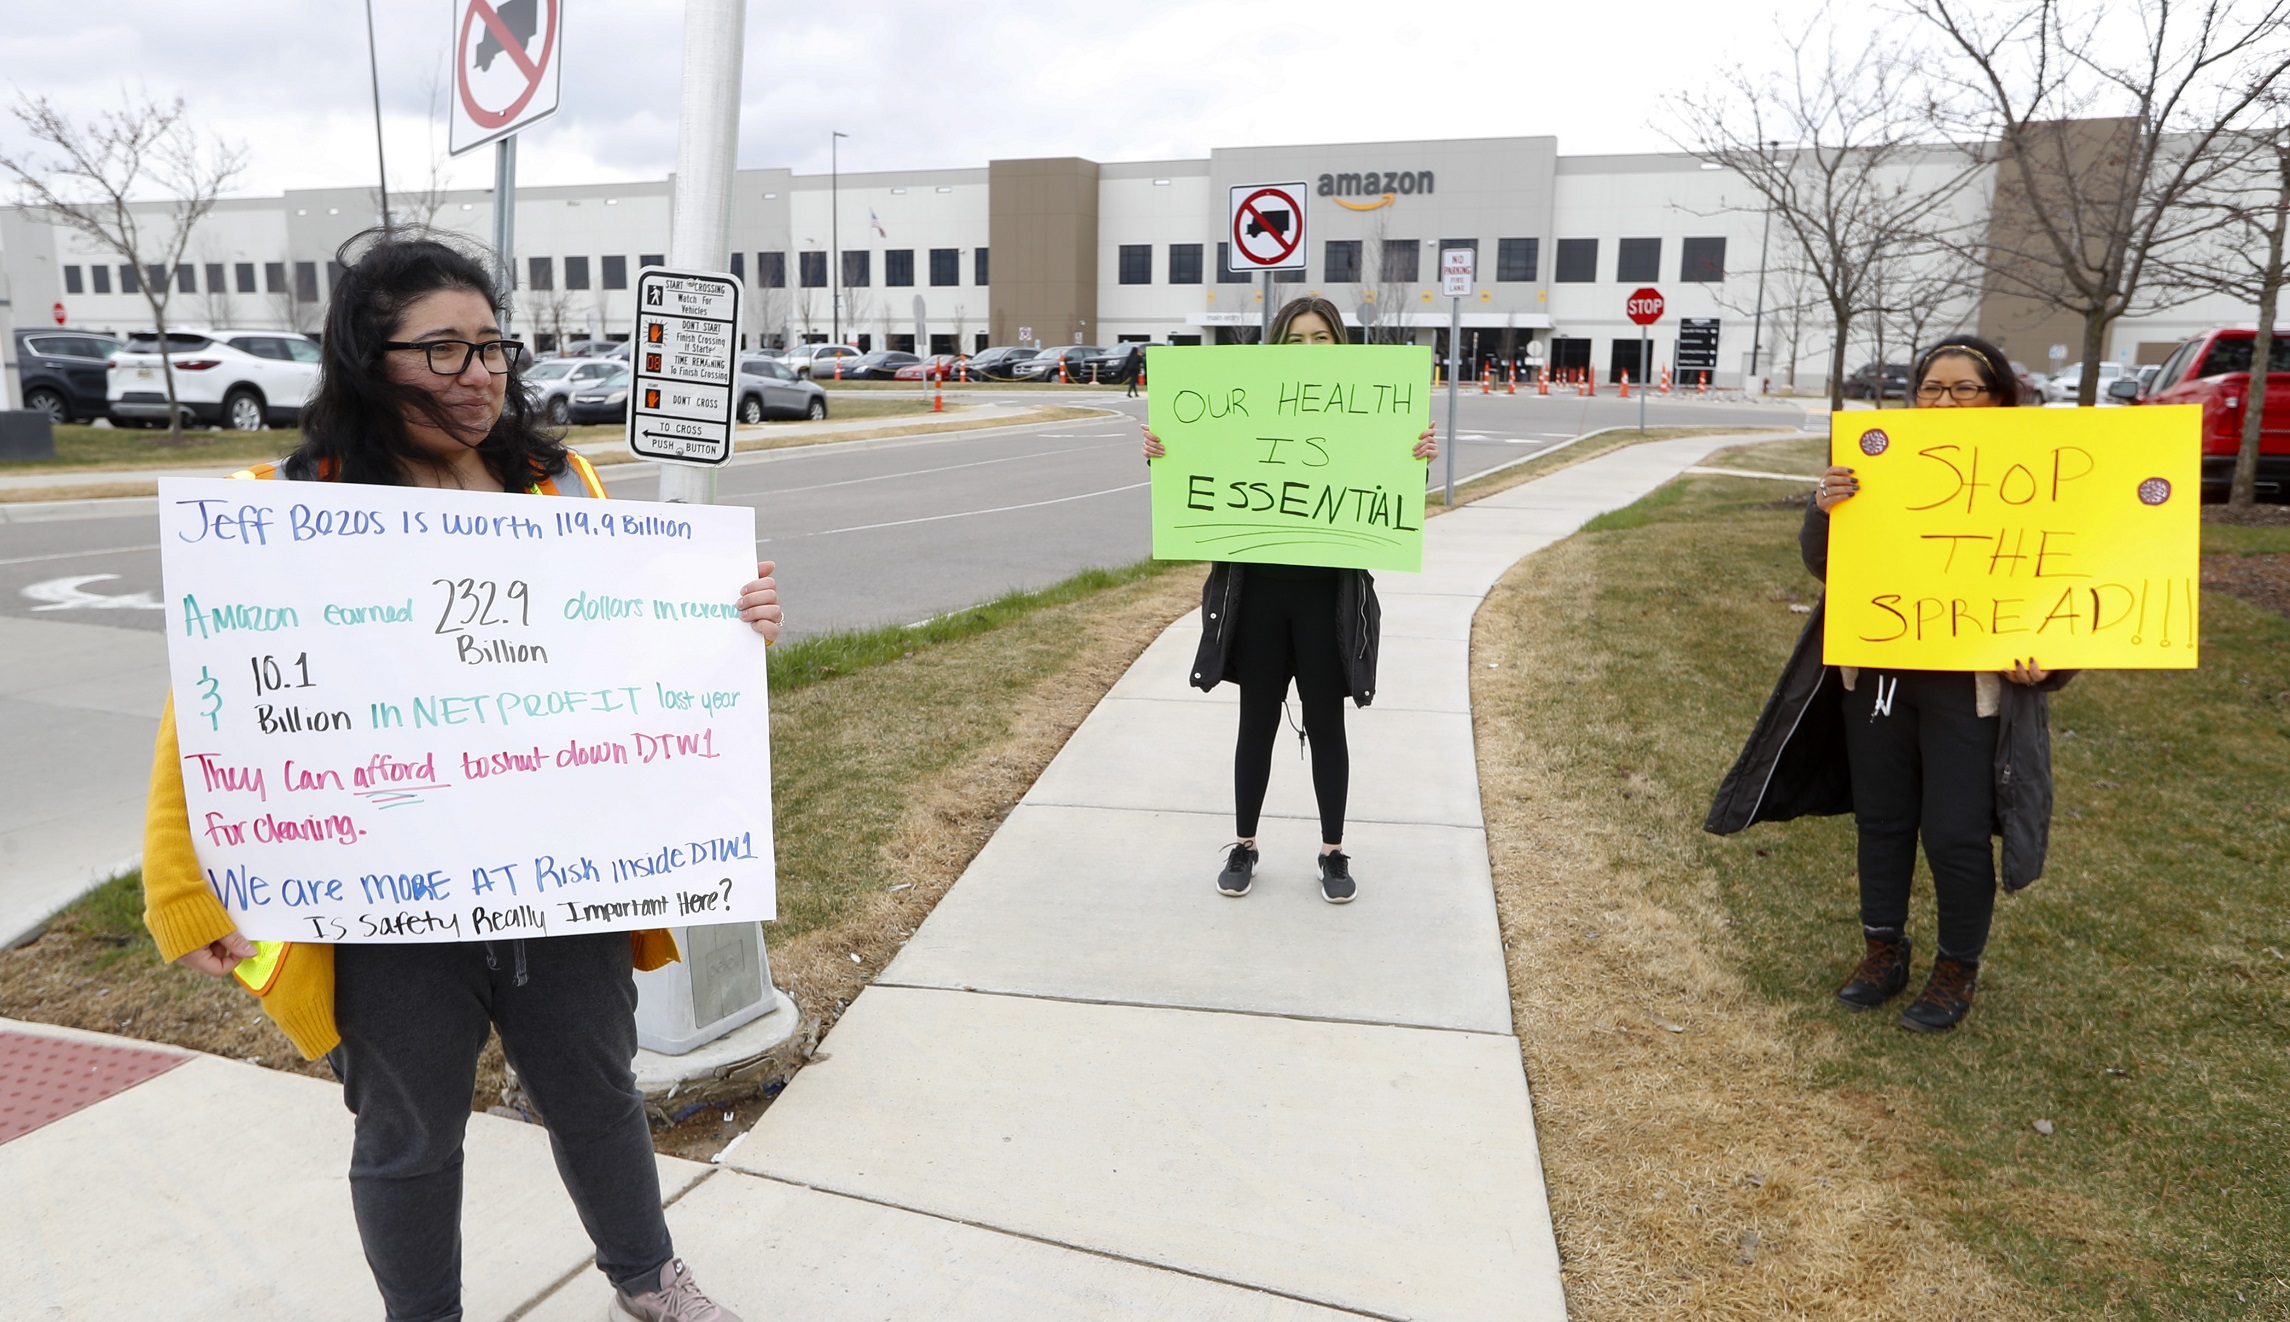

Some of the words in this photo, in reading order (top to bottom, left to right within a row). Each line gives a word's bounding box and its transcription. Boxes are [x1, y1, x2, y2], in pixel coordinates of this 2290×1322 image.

[1316, 170, 1434, 197] amazon
[1443, 266, 1472, 275] PARKING
[1451, 255, 1464, 264] NO
[665, 280, 683, 290] START
[694, 283, 725, 294] CROSSING
[678, 294, 697, 304] Watch
[702, 297, 712, 305] For
[681, 305, 707, 316] Vehicles
[1628, 298, 1663, 315] STOP
[676, 333, 695, 342] Finish
[698, 335, 725, 348] Crossing
[682, 320, 699, 331] DON'T
[703, 323, 721, 333] START
[675, 355, 688, 365] TIME
[692, 344, 716, 354] Starte
[671, 365, 677, 374] To
[679, 367, 698, 377] Finish
[700, 369, 728, 382] Crossing
[697, 398, 718, 409] CROSS
[1172, 388, 1250, 423] OUR
[1278, 381, 1413, 417] HEALTH
[660, 422, 670, 432] TO
[676, 424, 702, 436] CROSS
[652, 439, 674, 450] PUSH
[686, 443, 716, 454] BUTTON
[1256, 436, 1330, 467] IS
[176, 499, 274, 546] Jeff
[290, 504, 386, 542] Bezos
[556, 512, 615, 538] 119.9
[621, 513, 692, 540] Billion
[1919, 527, 2094, 579] THE
[183, 594, 299, 640] Amazon
[324, 597, 414, 626] earned
[432, 577, 529, 635] 232.9
[563, 590, 643, 621] dollars
[680, 601, 740, 620] revenu
[1858, 577, 2194, 649] SPREAD!!!
[456, 632, 549, 666] Billion
[251, 652, 317, 698] 10.1
[254, 703, 352, 735] Billion
[413, 695, 491, 730] NET
[496, 687, 642, 726] PROFIT
[656, 681, 695, 711] last
[701, 690, 741, 719] year
[184, 753, 267, 803] They
[353, 752, 437, 789] afford
[556, 740, 628, 768] down
[630, 728, 721, 764] DTW1
[207, 864, 272, 911] We
[282, 878, 344, 907] are
[471, 864, 518, 896] AT
[535, 855, 601, 893] Risk
[685, 832, 759, 866] DTW1
[303, 915, 347, 940] Is
[358, 910, 461, 938] Safety
[472, 904, 548, 937] Really
[556, 895, 670, 923] Important
[676, 878, 733, 916] Here?
